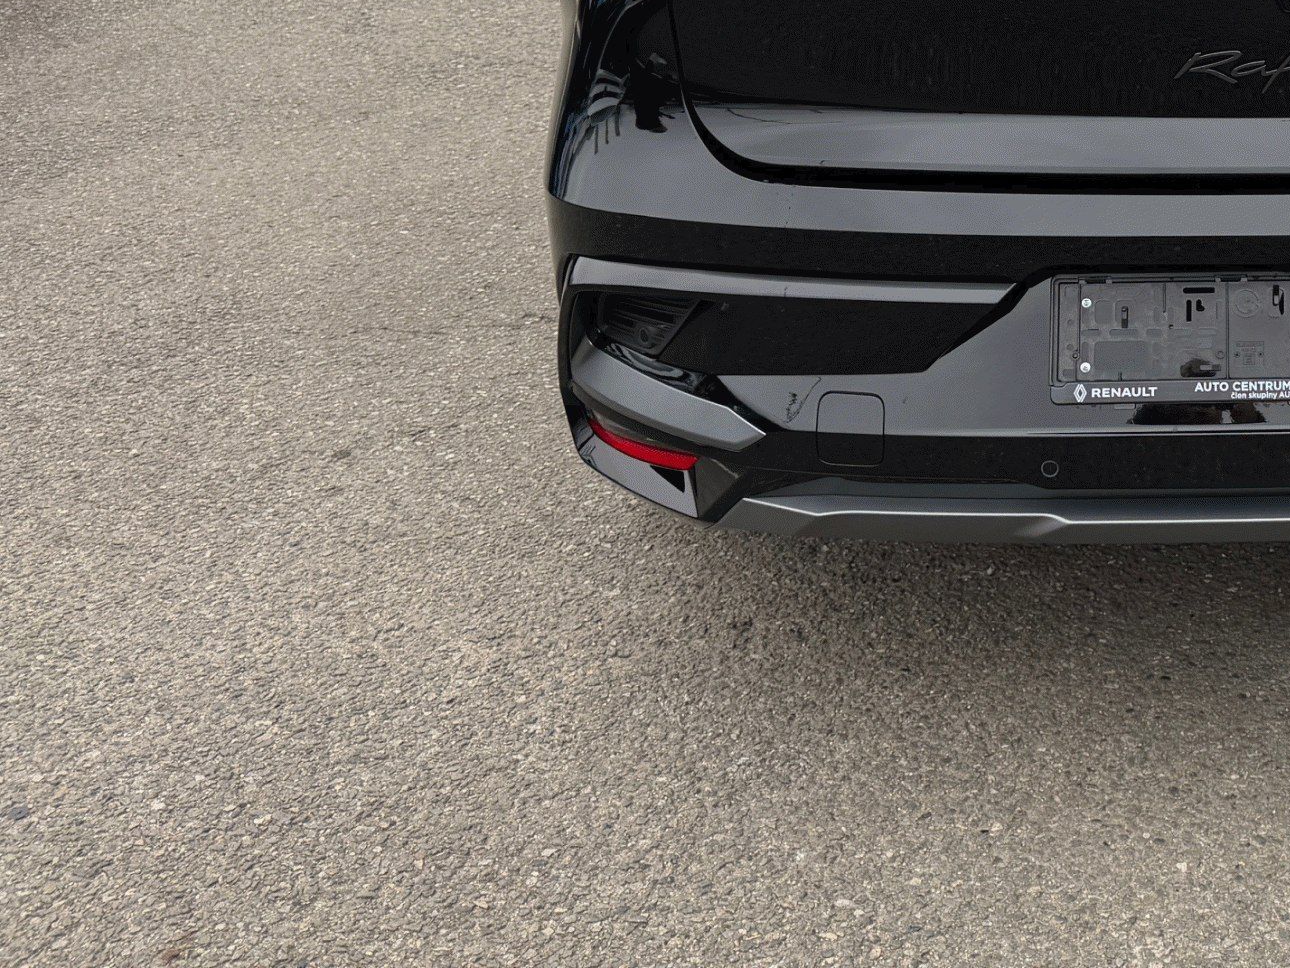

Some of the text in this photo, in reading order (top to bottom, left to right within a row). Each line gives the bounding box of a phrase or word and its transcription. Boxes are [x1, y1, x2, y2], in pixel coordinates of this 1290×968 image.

[1092, 386, 1158, 398] RENAULT
[1194, 381, 1229, 392] AUTO
[1232, 380, 1290, 391] CENTRUM
[1248, 391, 1277, 400] skupiny
